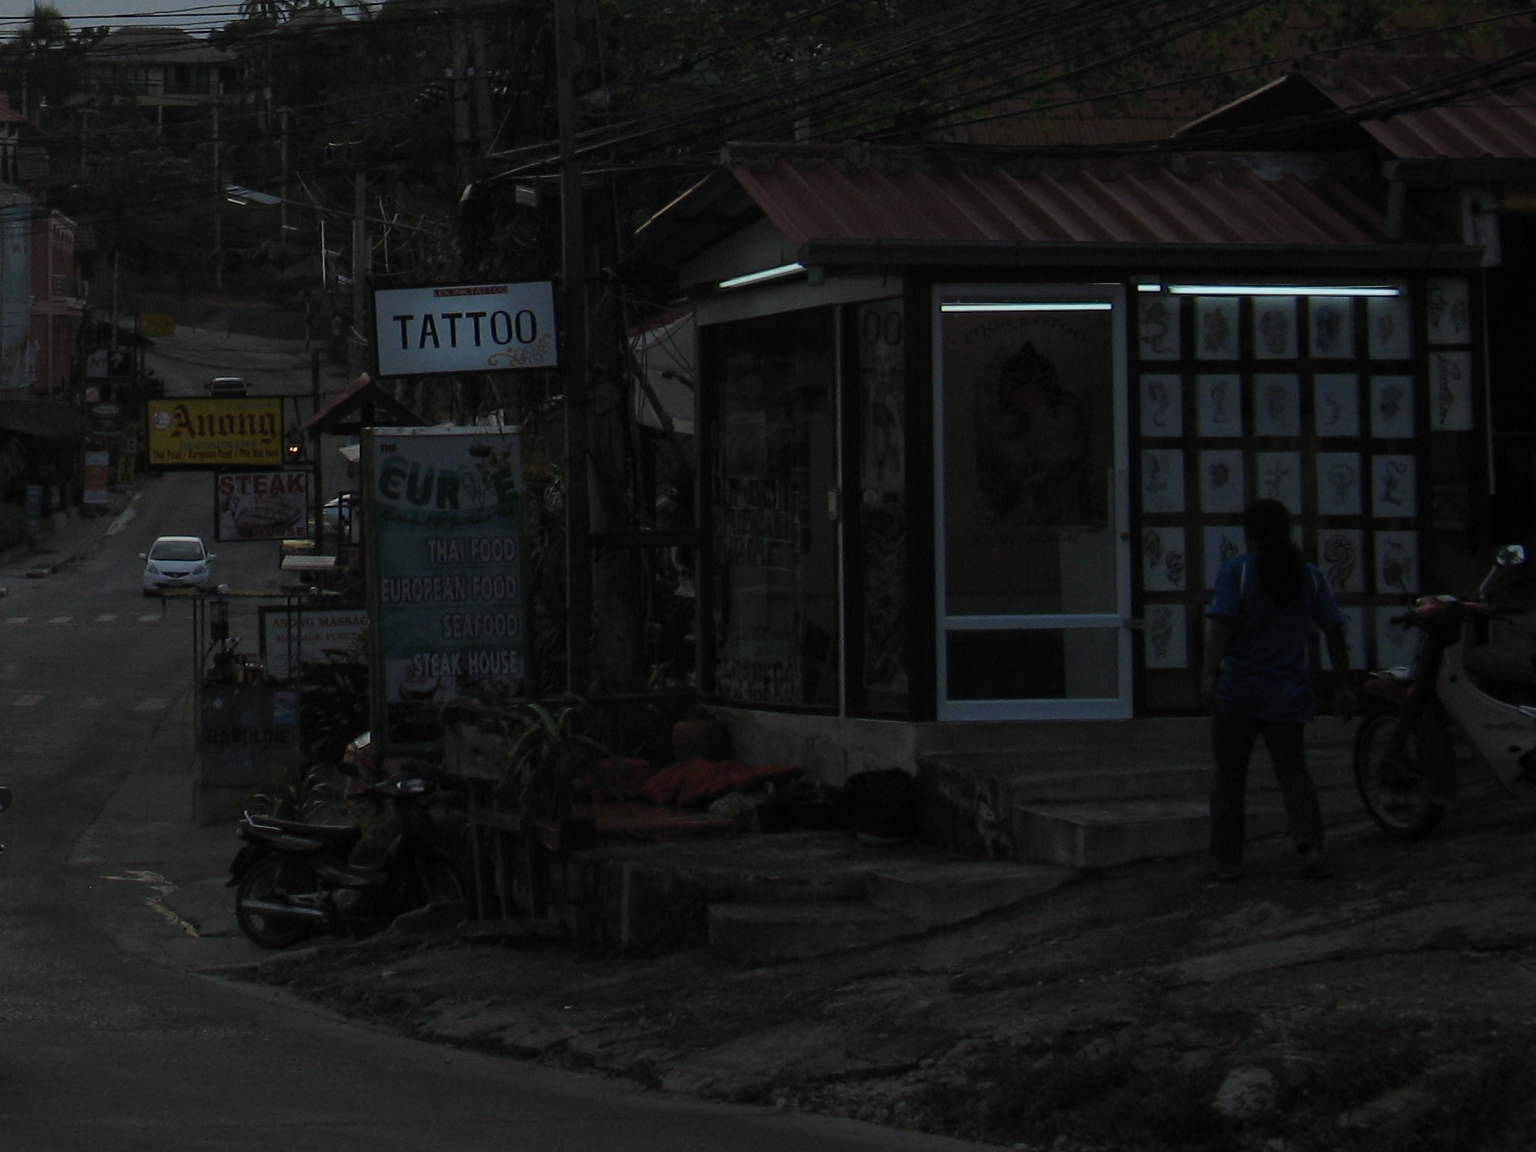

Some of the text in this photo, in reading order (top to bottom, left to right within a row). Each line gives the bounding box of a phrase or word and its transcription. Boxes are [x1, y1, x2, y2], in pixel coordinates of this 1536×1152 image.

[393, 309, 537, 349] TATTOO
[169, 403, 277, 445] Anong
[379, 443, 397, 453] THE
[219, 474, 305, 496] STEAK
[427, 537, 516, 564] THAI FOOD
[381, 575, 517, 603] EUROPEAN FOOD
[442, 613, 519, 639] SEAFOOD
[413, 650, 519, 677] STEAK HOUSE
